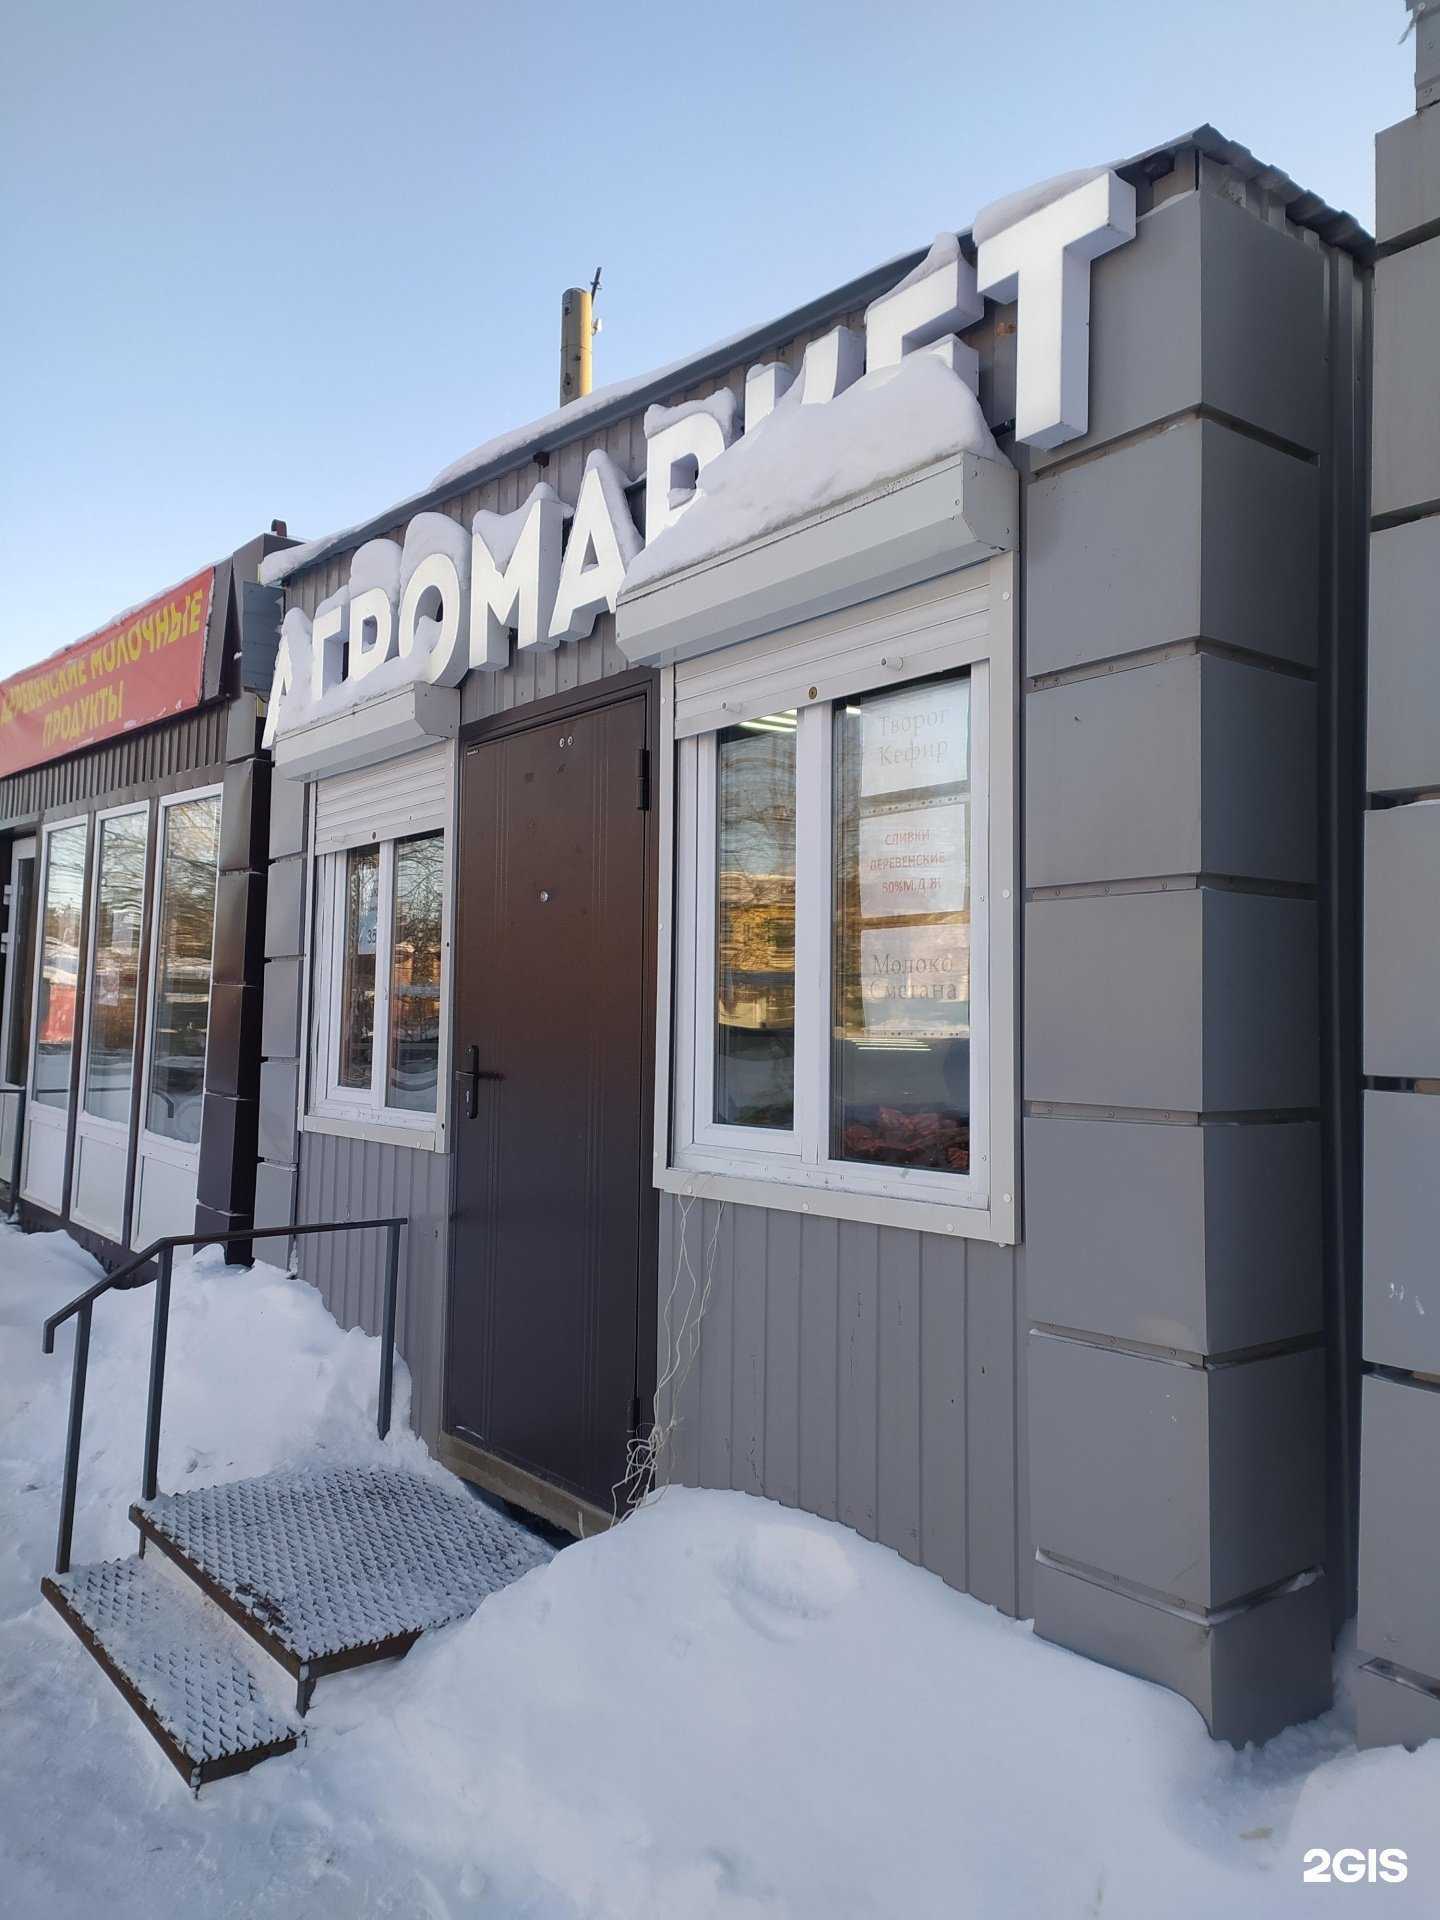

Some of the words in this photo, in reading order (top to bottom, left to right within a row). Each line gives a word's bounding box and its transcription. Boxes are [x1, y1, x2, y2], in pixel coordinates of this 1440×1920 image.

[91, 590, 203, 680] МОЛОЧНЫЕ
[42, 680, 124, 749] ПРОДУКТЫ
[880, 710, 947, 737] Творог
[880, 740, 948, 769] Кефир
[872, 954, 953, 976] Молоко
[870, 980, 957, 1001] Сметана
